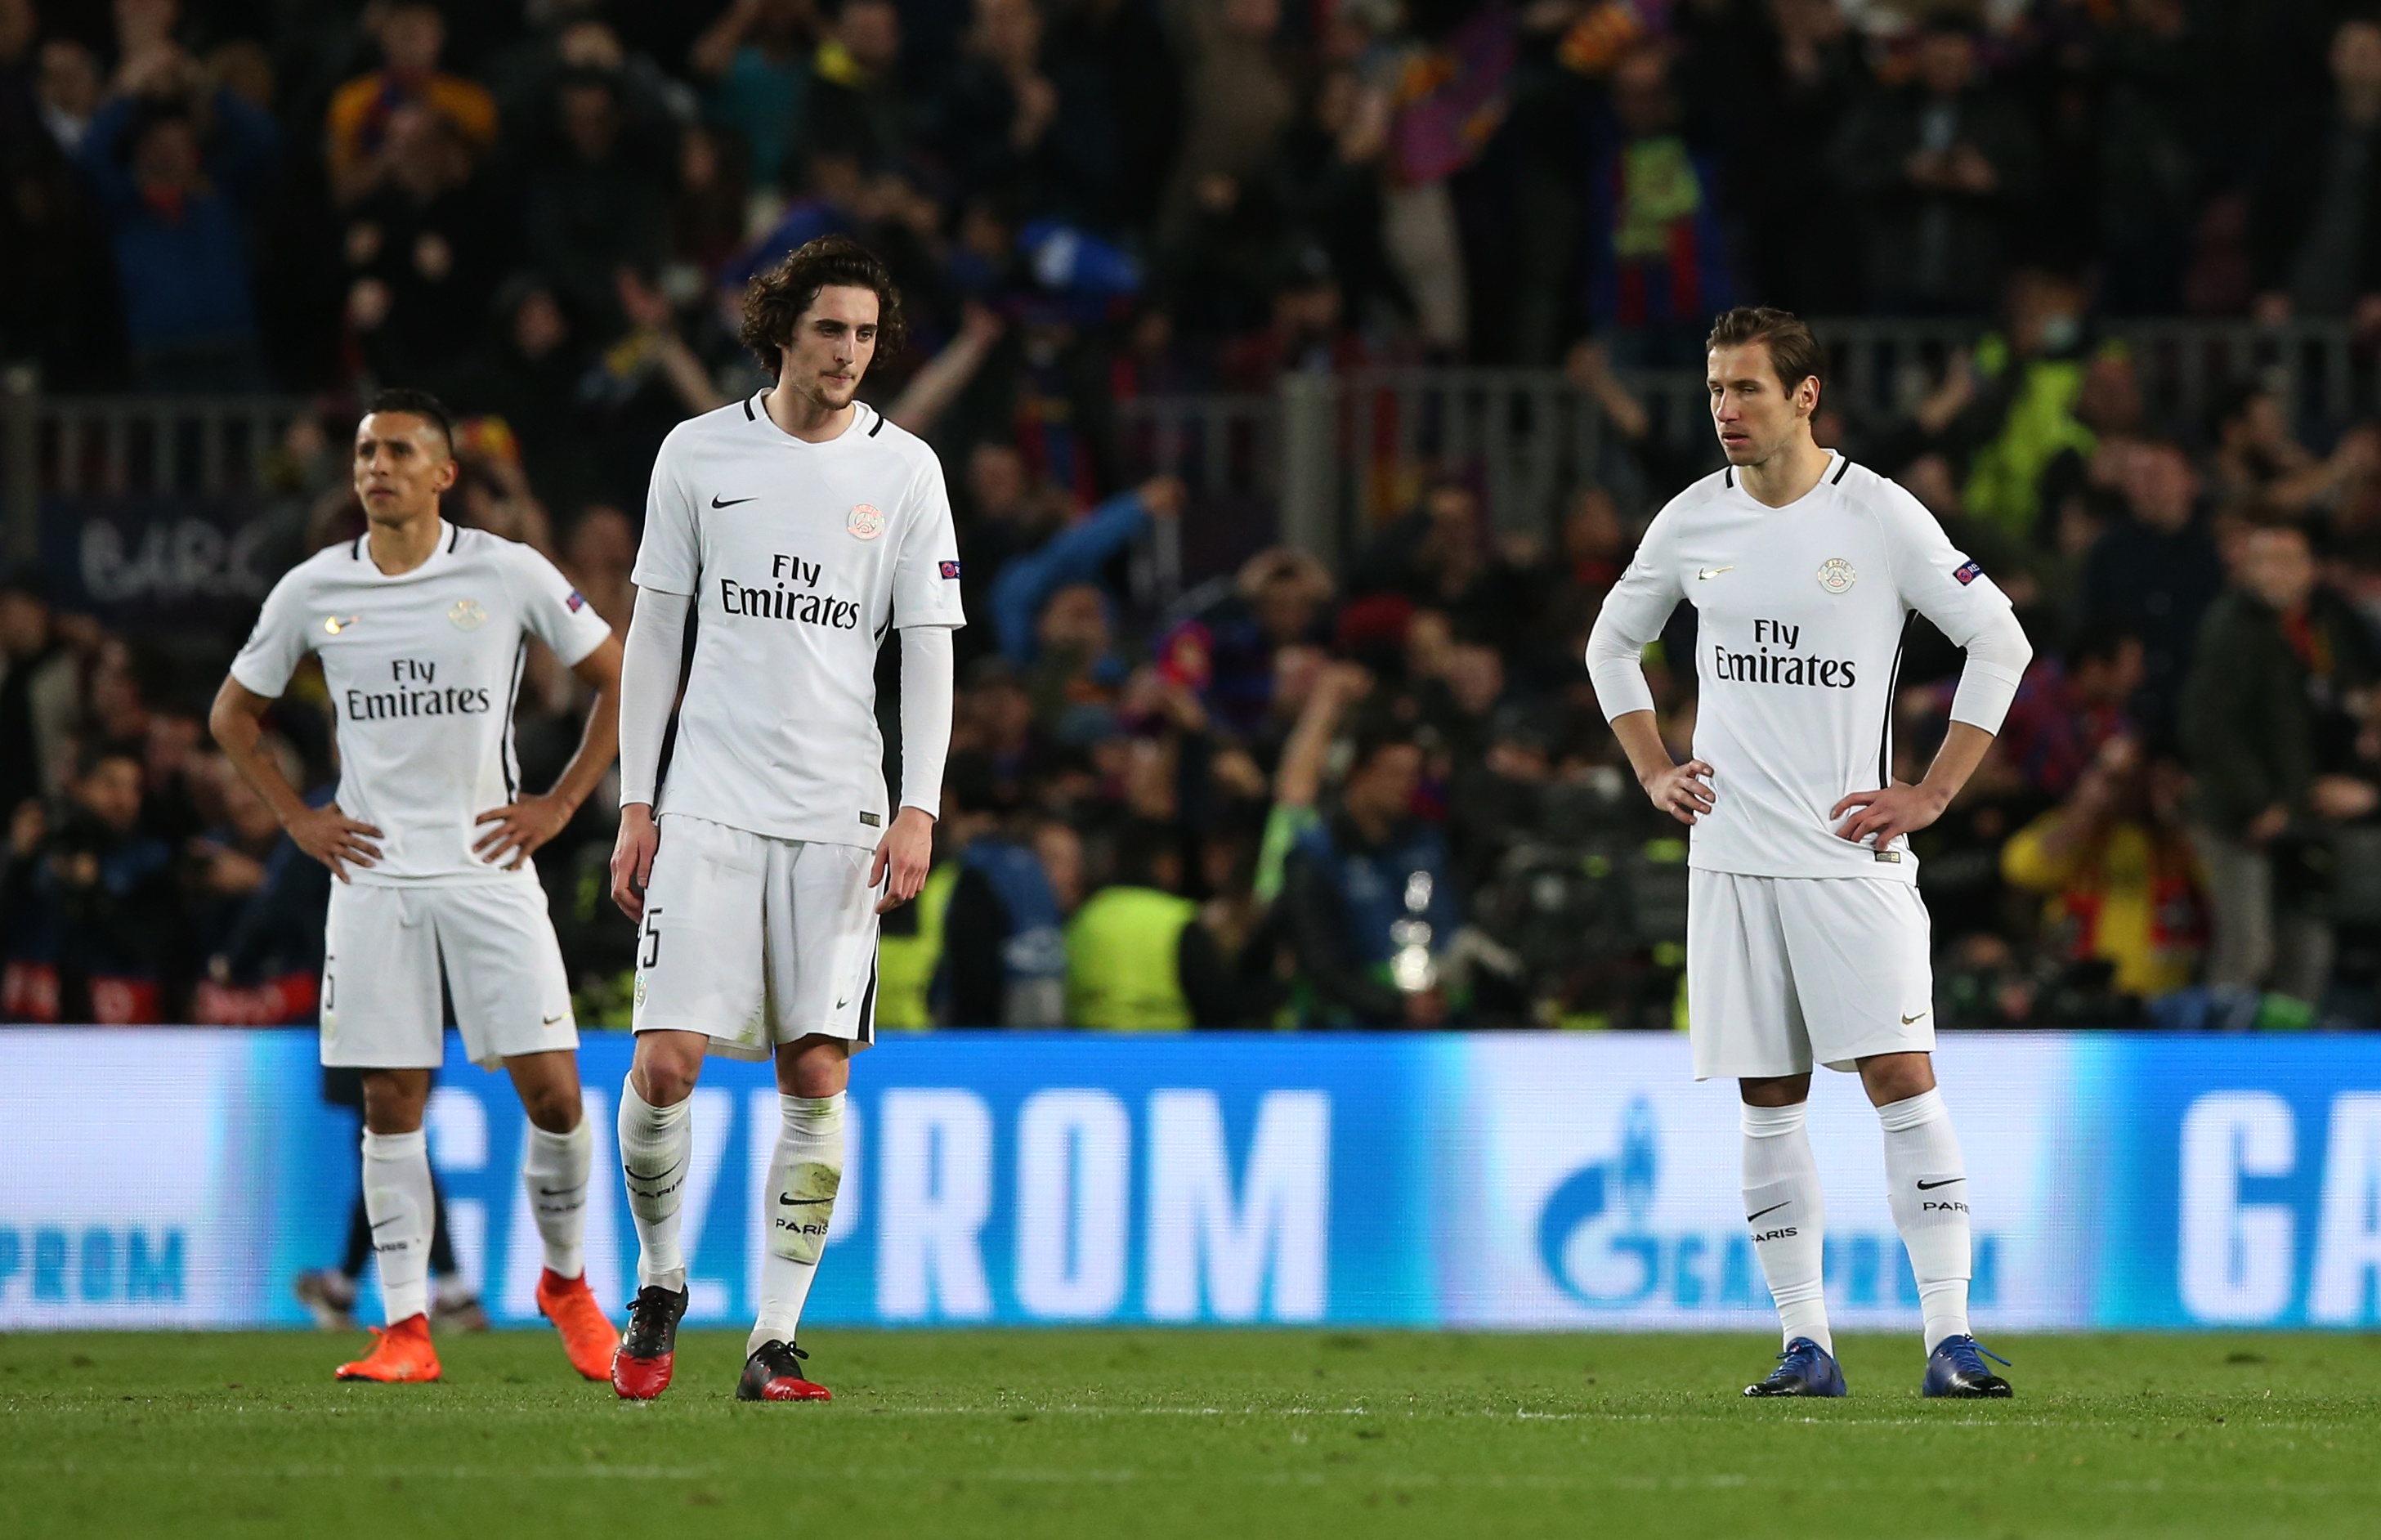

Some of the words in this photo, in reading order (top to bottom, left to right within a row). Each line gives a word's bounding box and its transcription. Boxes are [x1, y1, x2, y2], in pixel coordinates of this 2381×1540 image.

[771, 554, 821, 588] Fly
[721, 579, 860, 629] Emirates
[1754, 619, 1800, 650] Fly
[392, 659, 436, 684] Fly
[1715, 645, 1856, 688] Emirates
[347, 685, 490, 721] Emirates
[638, 907, 664, 969] 5
[1923, 1202, 1970, 1215] PARI
[776, 1218, 829, 1235] PARIS
[374, 1241, 408, 1253] ARIS
